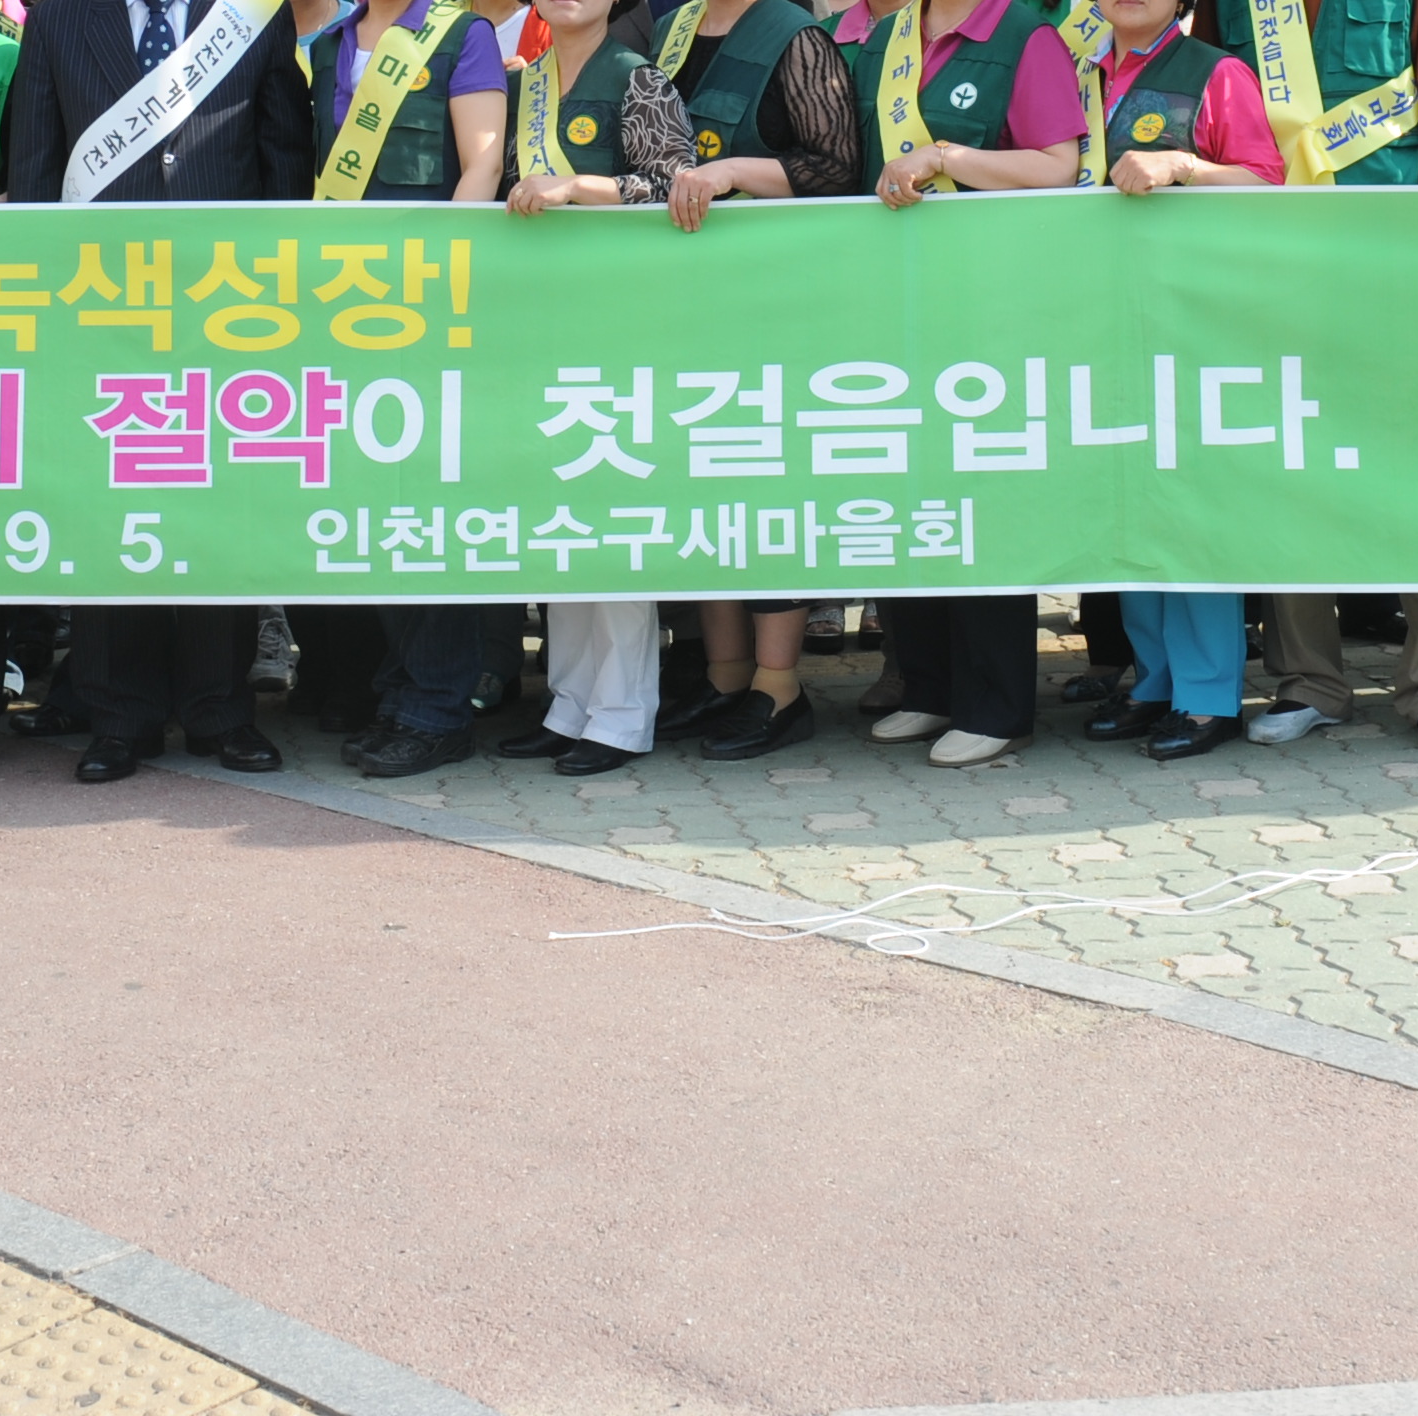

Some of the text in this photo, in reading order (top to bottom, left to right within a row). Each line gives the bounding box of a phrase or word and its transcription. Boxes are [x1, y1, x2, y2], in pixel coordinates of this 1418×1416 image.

[83, 365, 462, 491] 절약이
[537, 354, 1360, 482] 첫걸음입니다.
[119, 512, 189, 575] 5.
[306, 497, 976, 574] 인천연수구새마을회
